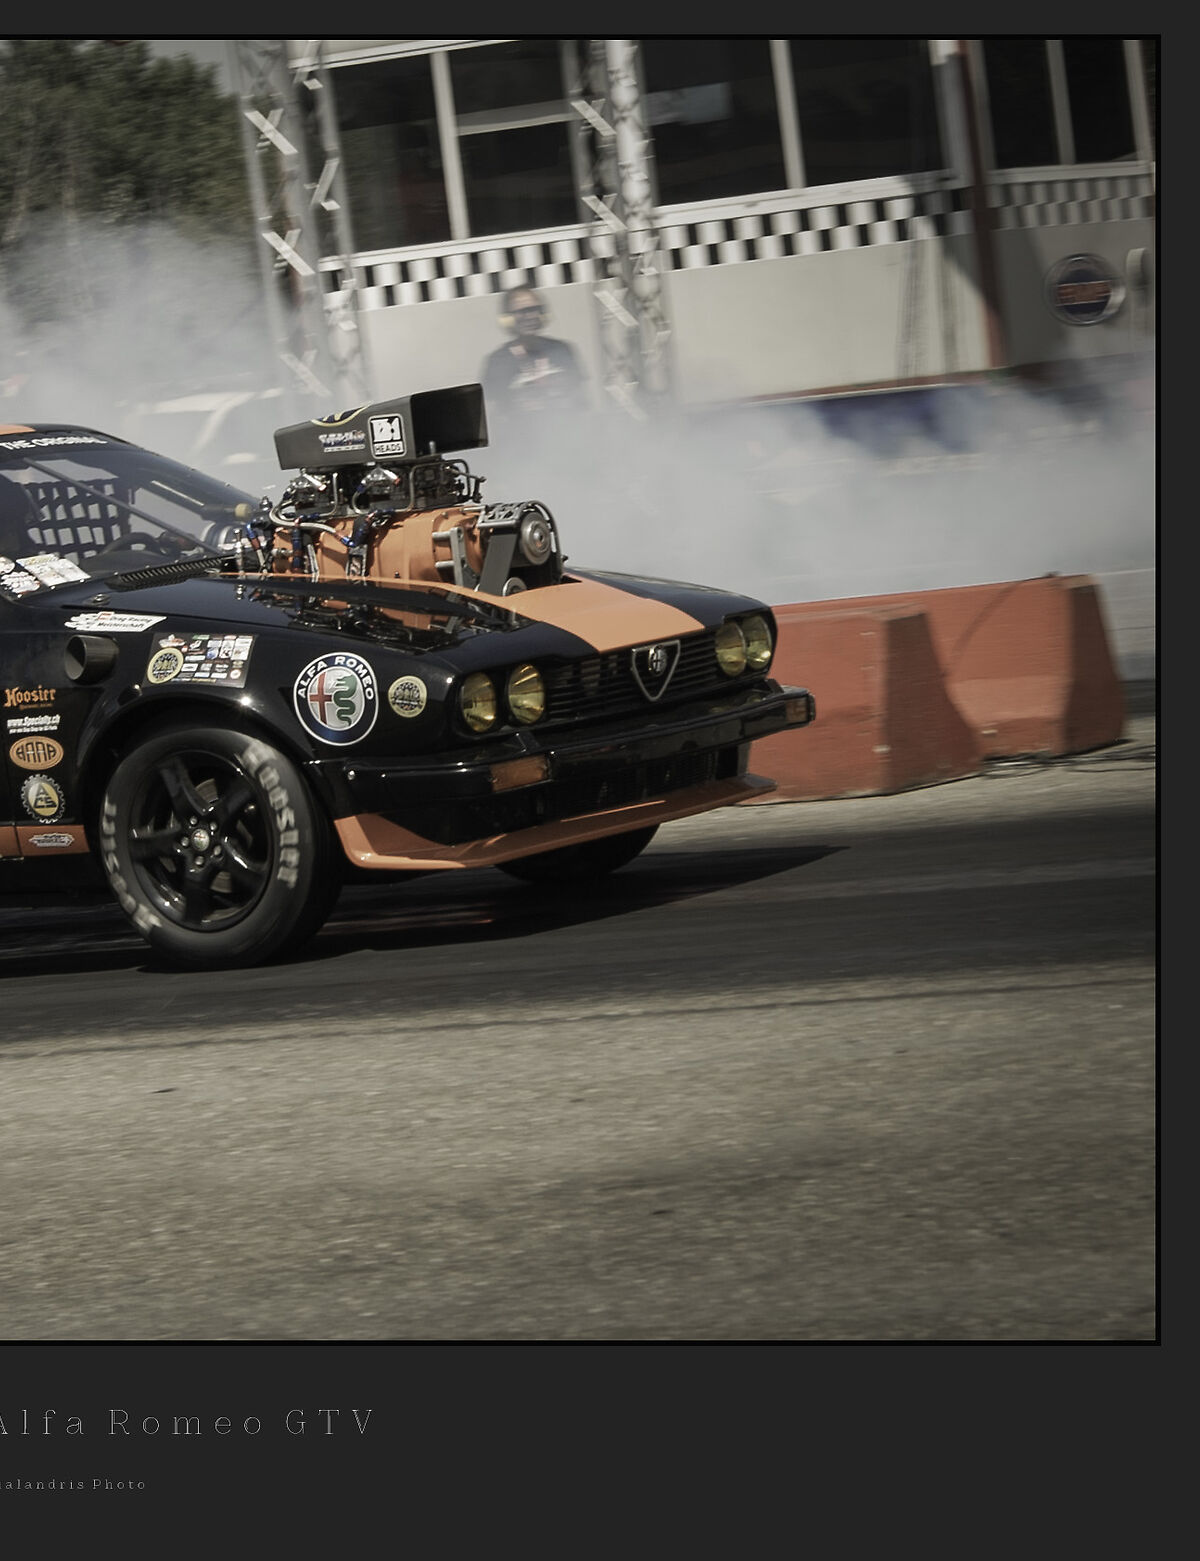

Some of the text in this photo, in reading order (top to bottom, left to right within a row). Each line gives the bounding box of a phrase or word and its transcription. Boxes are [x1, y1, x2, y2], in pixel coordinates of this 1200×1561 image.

[32, 436, 107, 448] ORIGINAL
[375, 443, 401, 453] HEADS
[297, 660, 328, 699] ALFA
[334, 656, 375, 701] ROMEO
[4, 684, 57, 708] Hoosier
